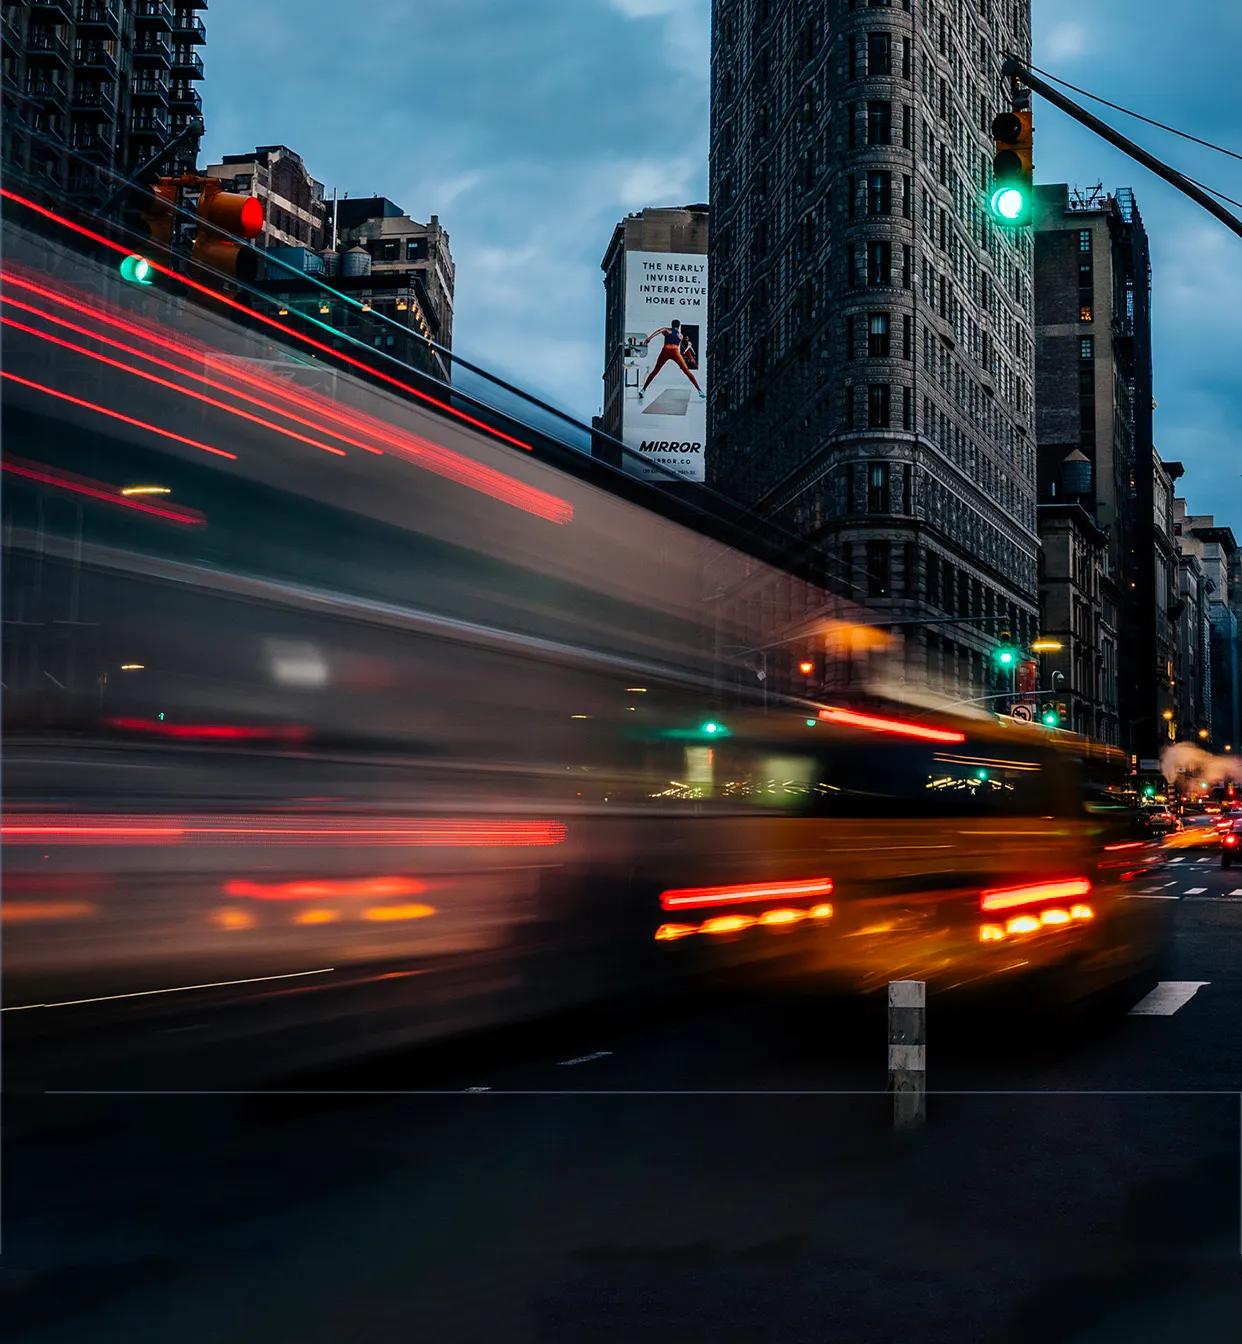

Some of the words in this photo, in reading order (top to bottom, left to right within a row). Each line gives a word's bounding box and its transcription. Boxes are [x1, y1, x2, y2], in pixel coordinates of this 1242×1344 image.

[643, 262, 662, 270] THE
[666, 263, 705, 272] NEARLY
[646, 274, 701, 284] INVISIBLE,
[639, 285, 707, 295] INTERACTIVE
[645, 297, 675, 305] HOME
[679, 298, 701, 306] GYM
[639, 440, 702, 453] MIRROR
